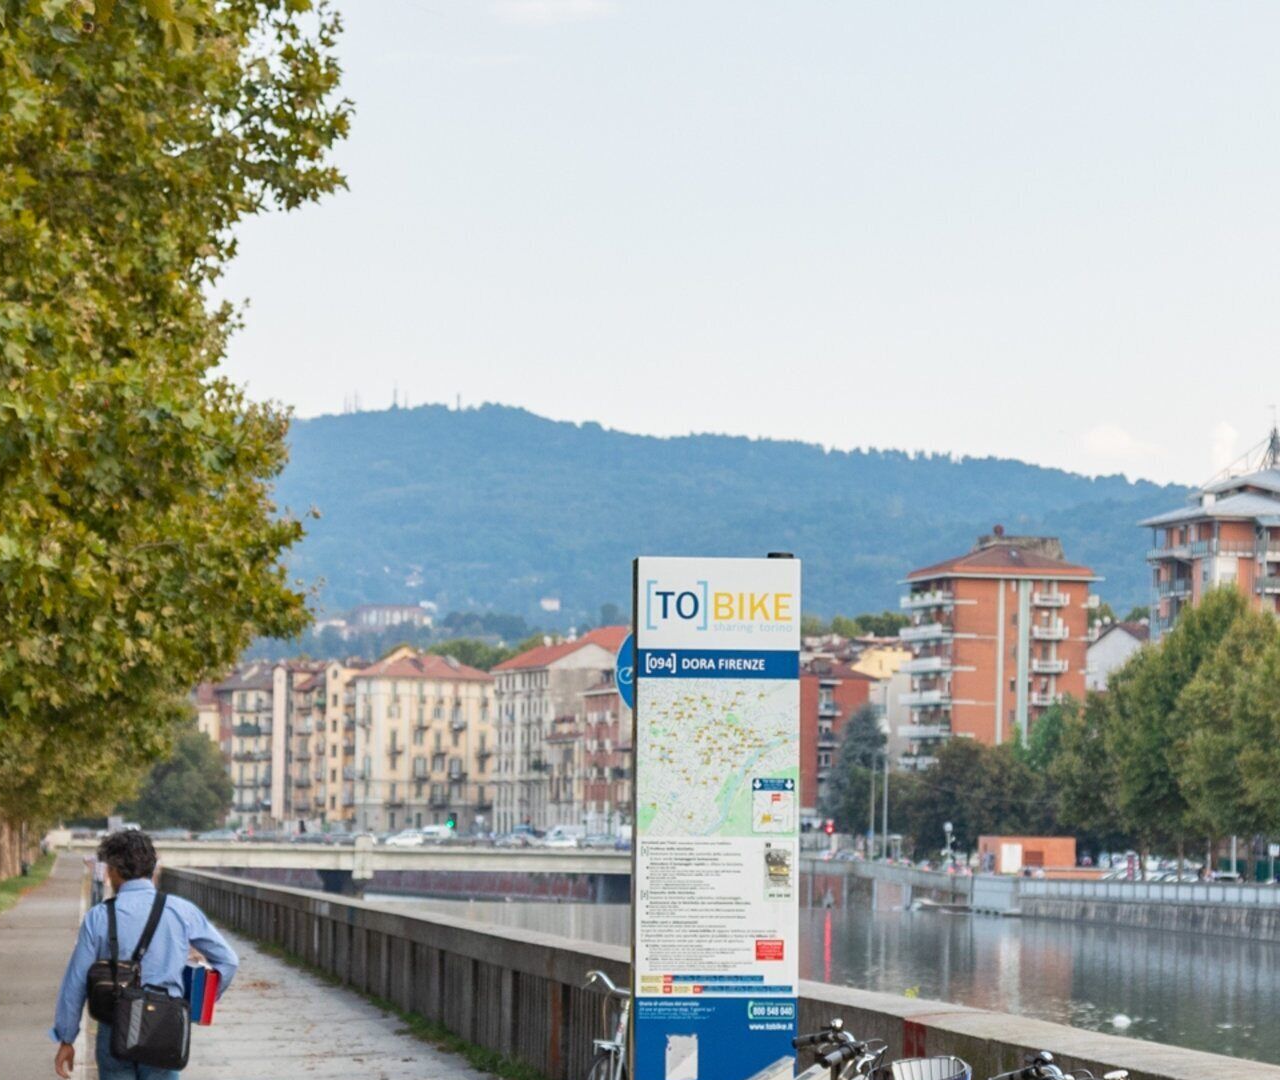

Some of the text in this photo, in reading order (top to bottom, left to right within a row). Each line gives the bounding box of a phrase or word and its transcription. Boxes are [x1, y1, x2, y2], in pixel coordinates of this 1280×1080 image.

[713, 622, 793, 633] sharing torino
[681, 658, 716, 670] DORA
[719, 658, 766, 671] FIRENZE
[753, 1007, 765, 1016] 800
[780, 1007, 793, 1016] 040
